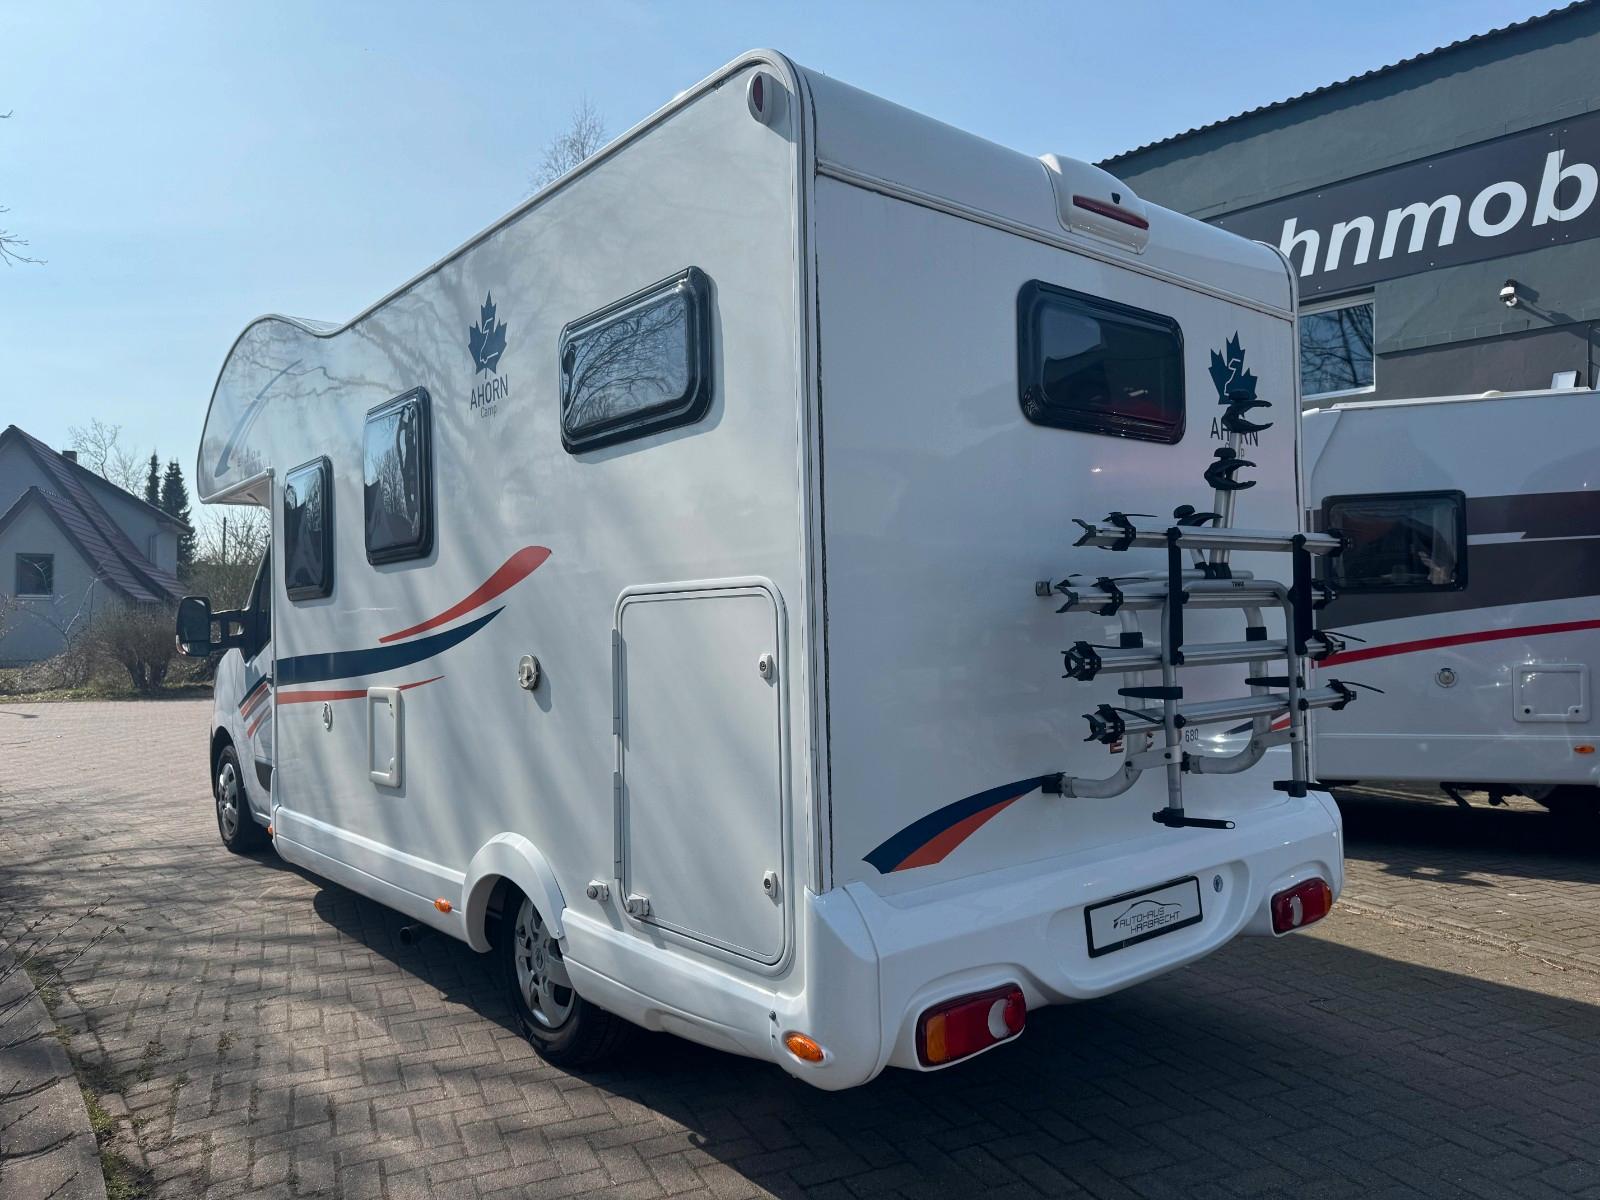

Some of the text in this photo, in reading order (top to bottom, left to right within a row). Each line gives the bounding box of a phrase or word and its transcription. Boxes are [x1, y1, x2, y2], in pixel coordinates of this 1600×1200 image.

[469, 373, 508, 410] AHORN
[480, 404, 497, 418] Camp
[1185, 728, 1199, 742] 680
[1119, 907, 1165, 928] AUTOHAUS
